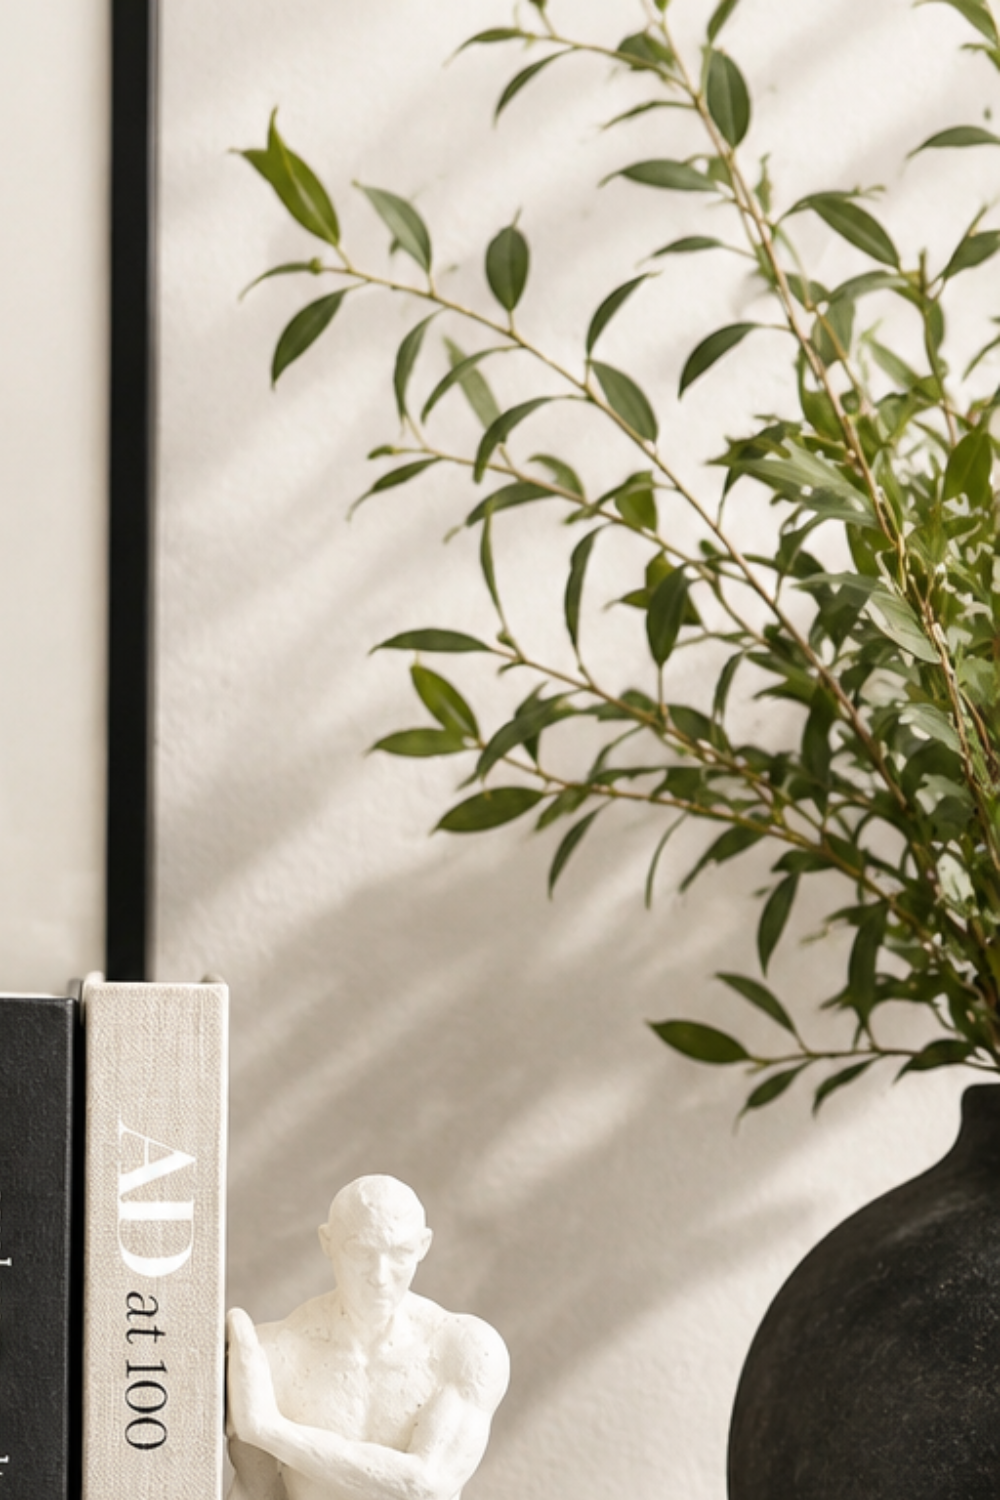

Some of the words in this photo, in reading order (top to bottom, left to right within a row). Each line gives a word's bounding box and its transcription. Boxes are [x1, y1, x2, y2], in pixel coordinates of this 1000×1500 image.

[117, 1120, 197, 1278] AD
[125, 1291, 166, 1344] at
[124, 1360, 168, 1451] 100
